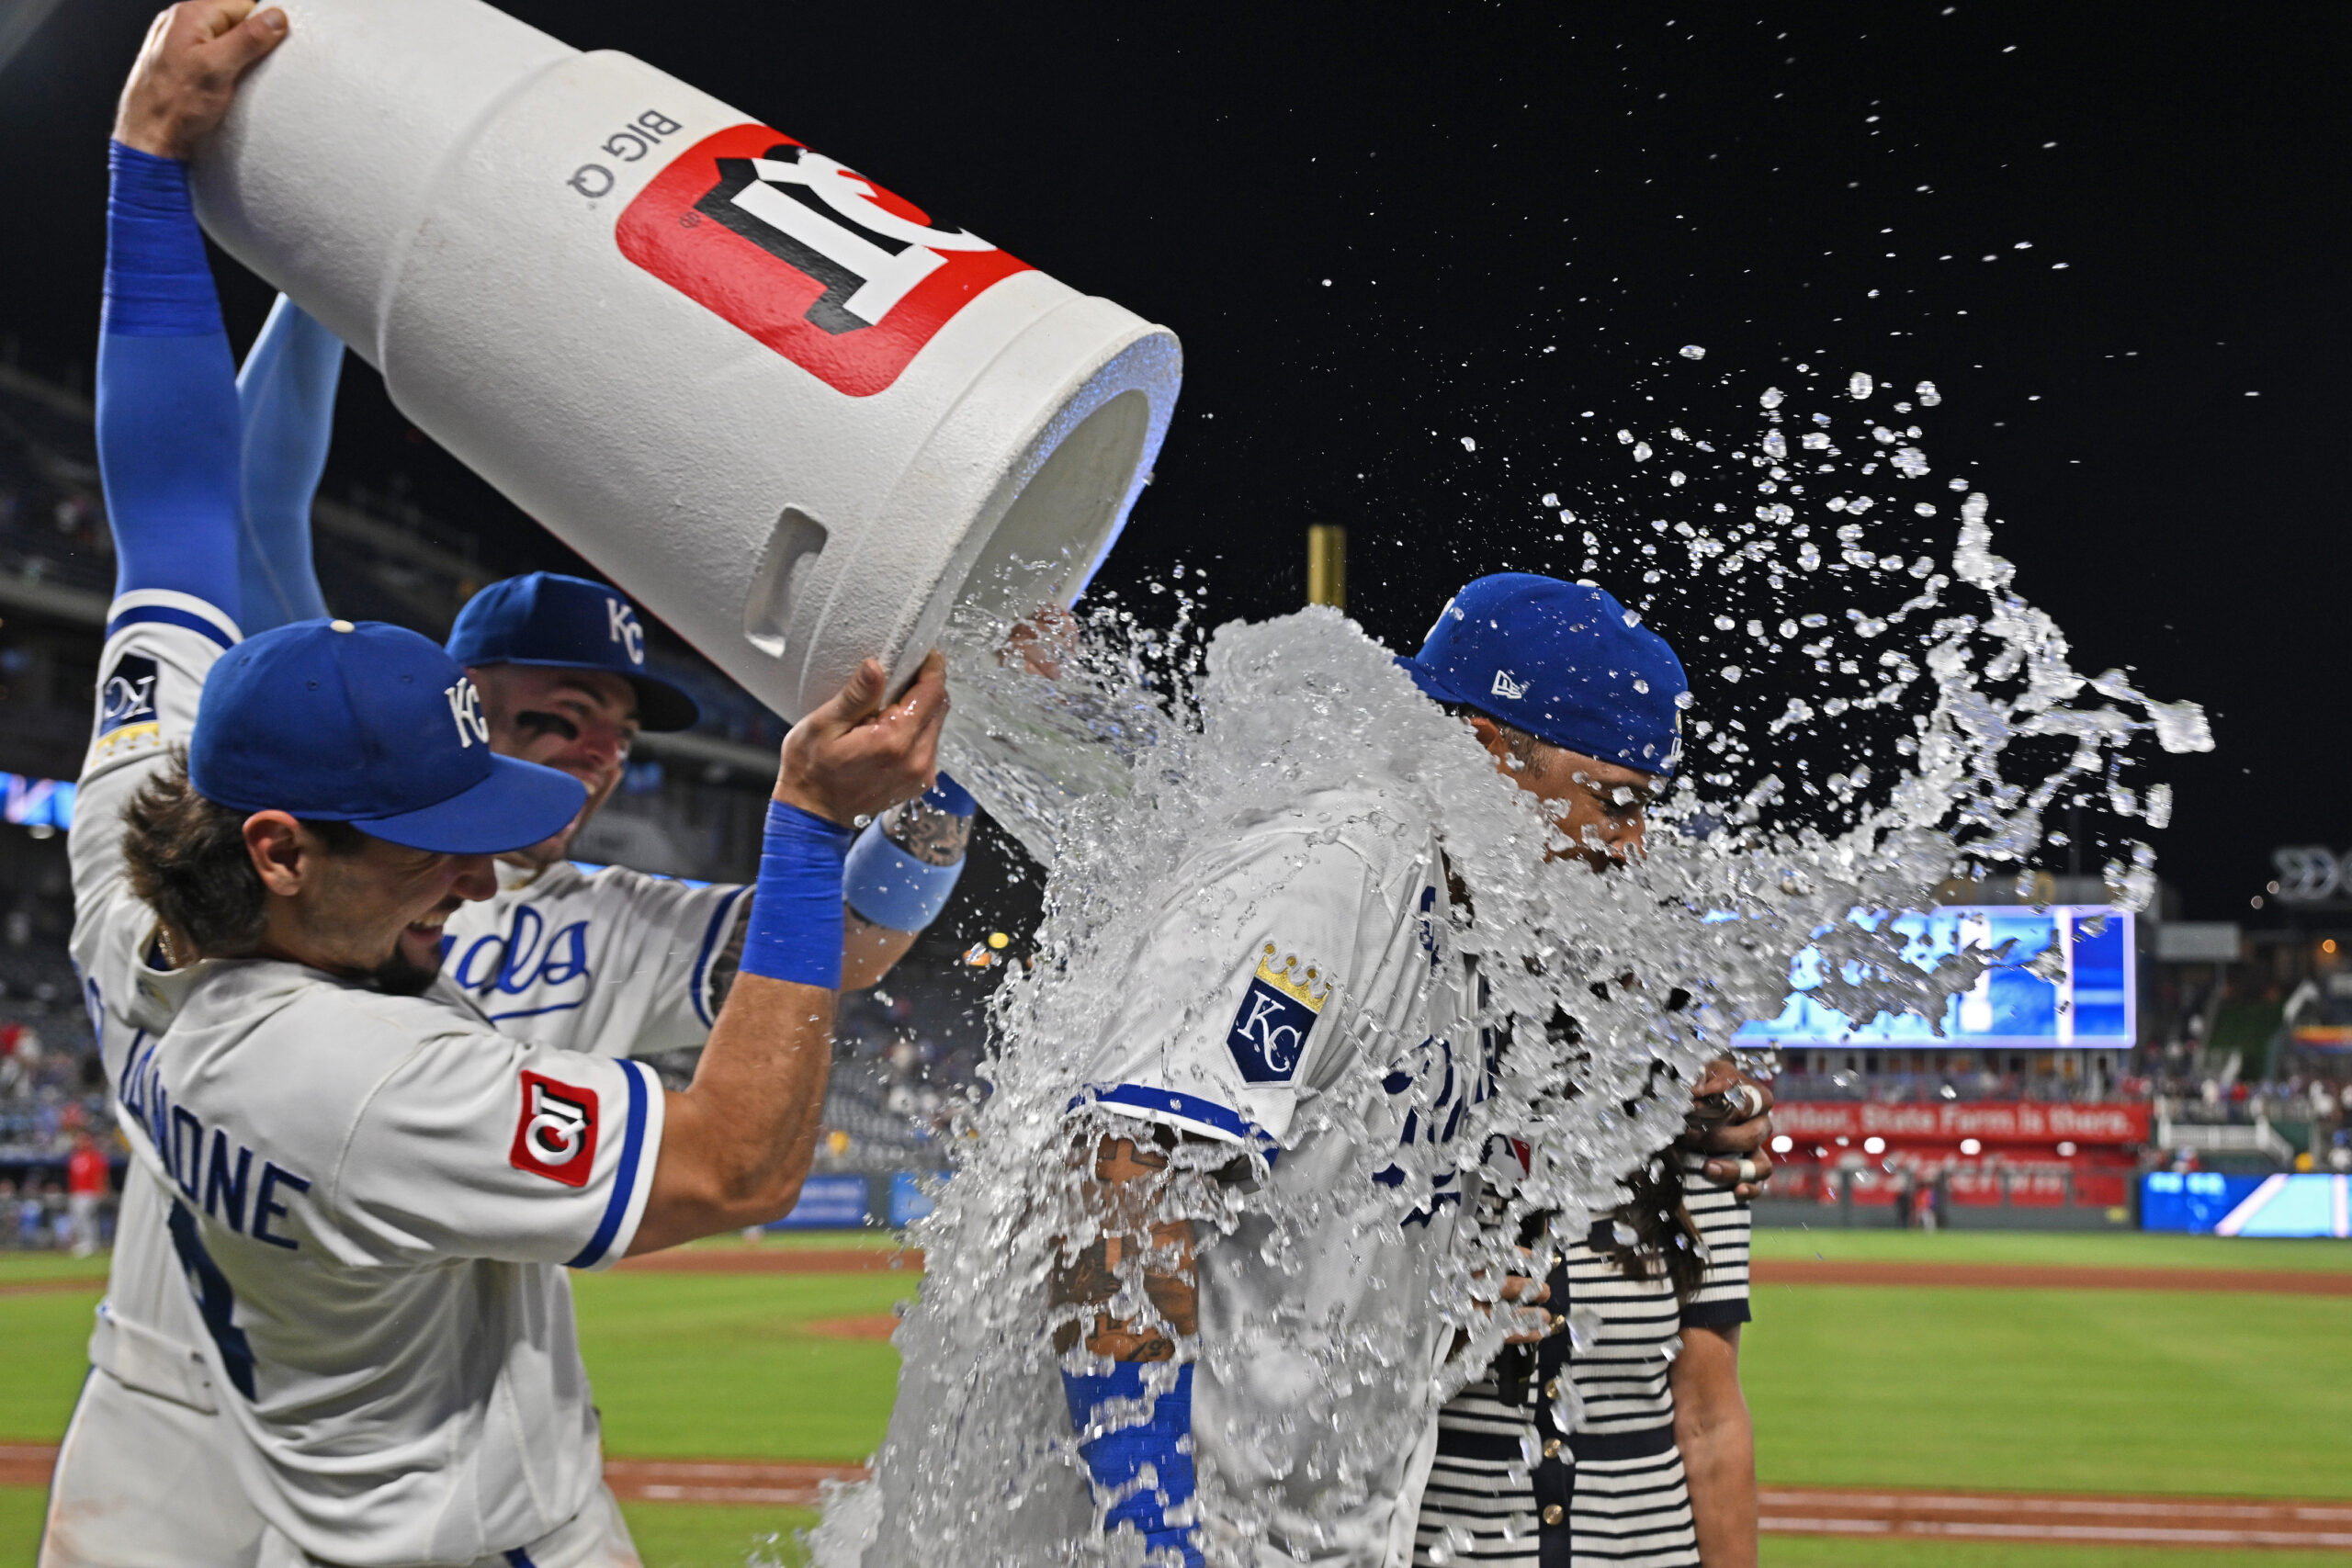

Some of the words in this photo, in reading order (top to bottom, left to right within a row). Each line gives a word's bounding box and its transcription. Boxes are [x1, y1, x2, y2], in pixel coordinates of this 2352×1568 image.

[602, 108, 683, 163] BIG
[566, 164, 616, 199] Q
[605, 596, 644, 666] KC
[103, 673, 157, 722] KC
[444, 676, 491, 750] KC
[441, 904, 591, 996] als
[1237, 990, 1303, 1074] KC
[526, 1081, 593, 1166] QT
[1860, 1104, 1936, 1134] State
[1940, 1104, 2015, 1134] Farm
[2018, 1103, 2045, 1135] is
[2048, 1105, 2135, 1136] there.
